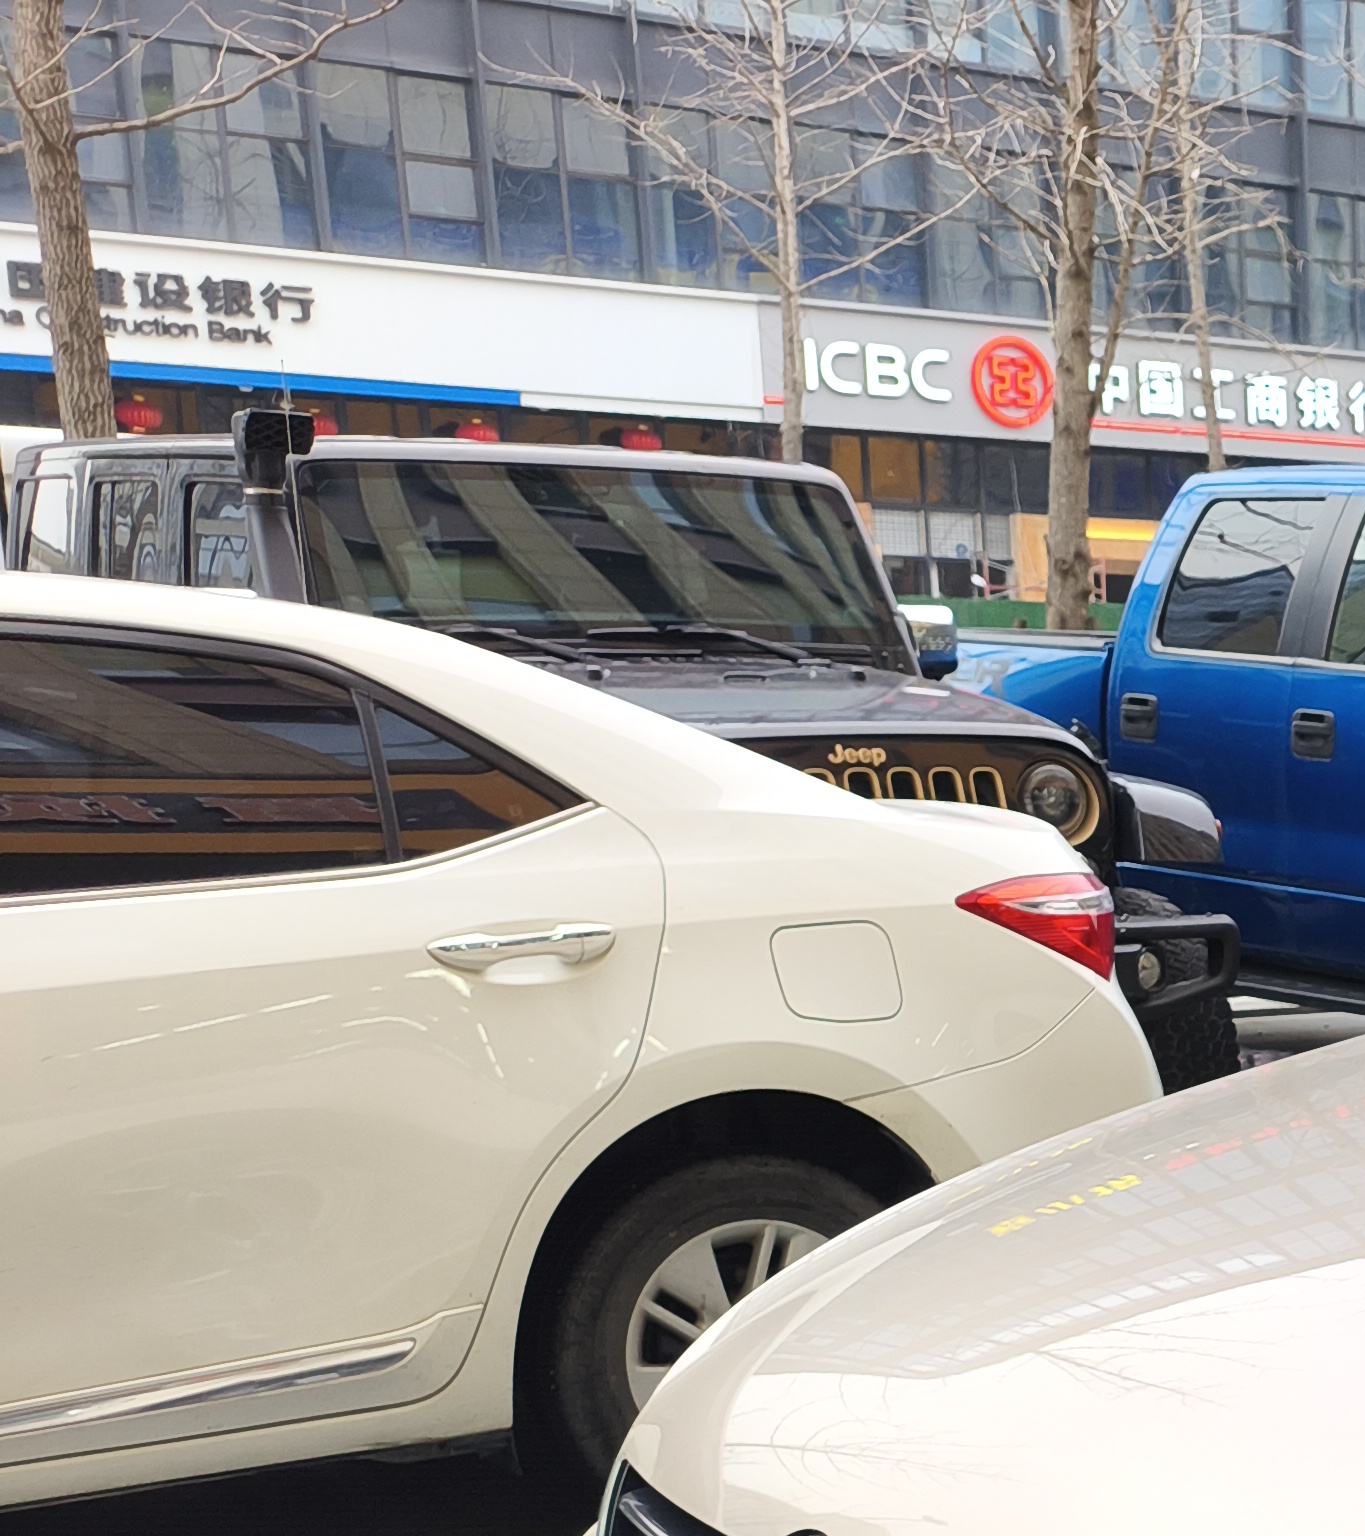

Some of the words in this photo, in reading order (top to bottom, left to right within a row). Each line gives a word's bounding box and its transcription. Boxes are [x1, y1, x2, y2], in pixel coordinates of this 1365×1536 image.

[207, 320, 273, 346] Bank
[803, 337, 952, 402] ICBC
[827, 743, 887, 767] Jeep
